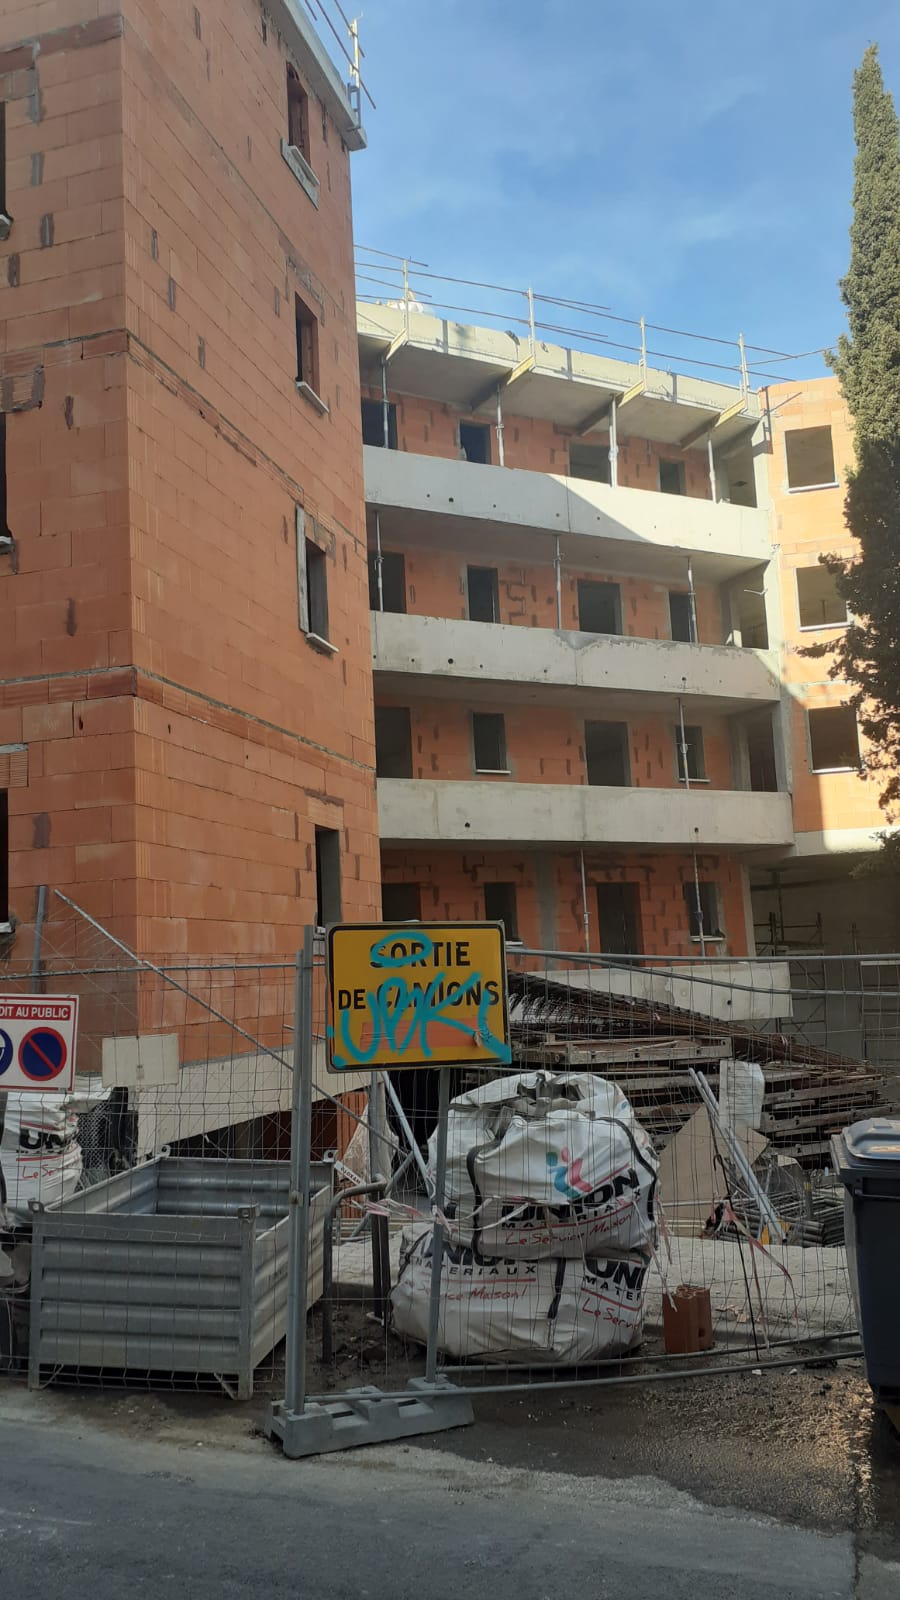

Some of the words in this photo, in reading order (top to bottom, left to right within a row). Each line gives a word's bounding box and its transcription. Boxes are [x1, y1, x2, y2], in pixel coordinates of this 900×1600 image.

[370, 941, 470, 968] SORTIE
[338, 989, 366, 1010] DE
[15, 1006, 29, 1018] AU
[31, 1006, 69, 1019] PUBLIC
[505, 1231, 528, 1246] Le
[582, 1297, 601, 1318] Le
